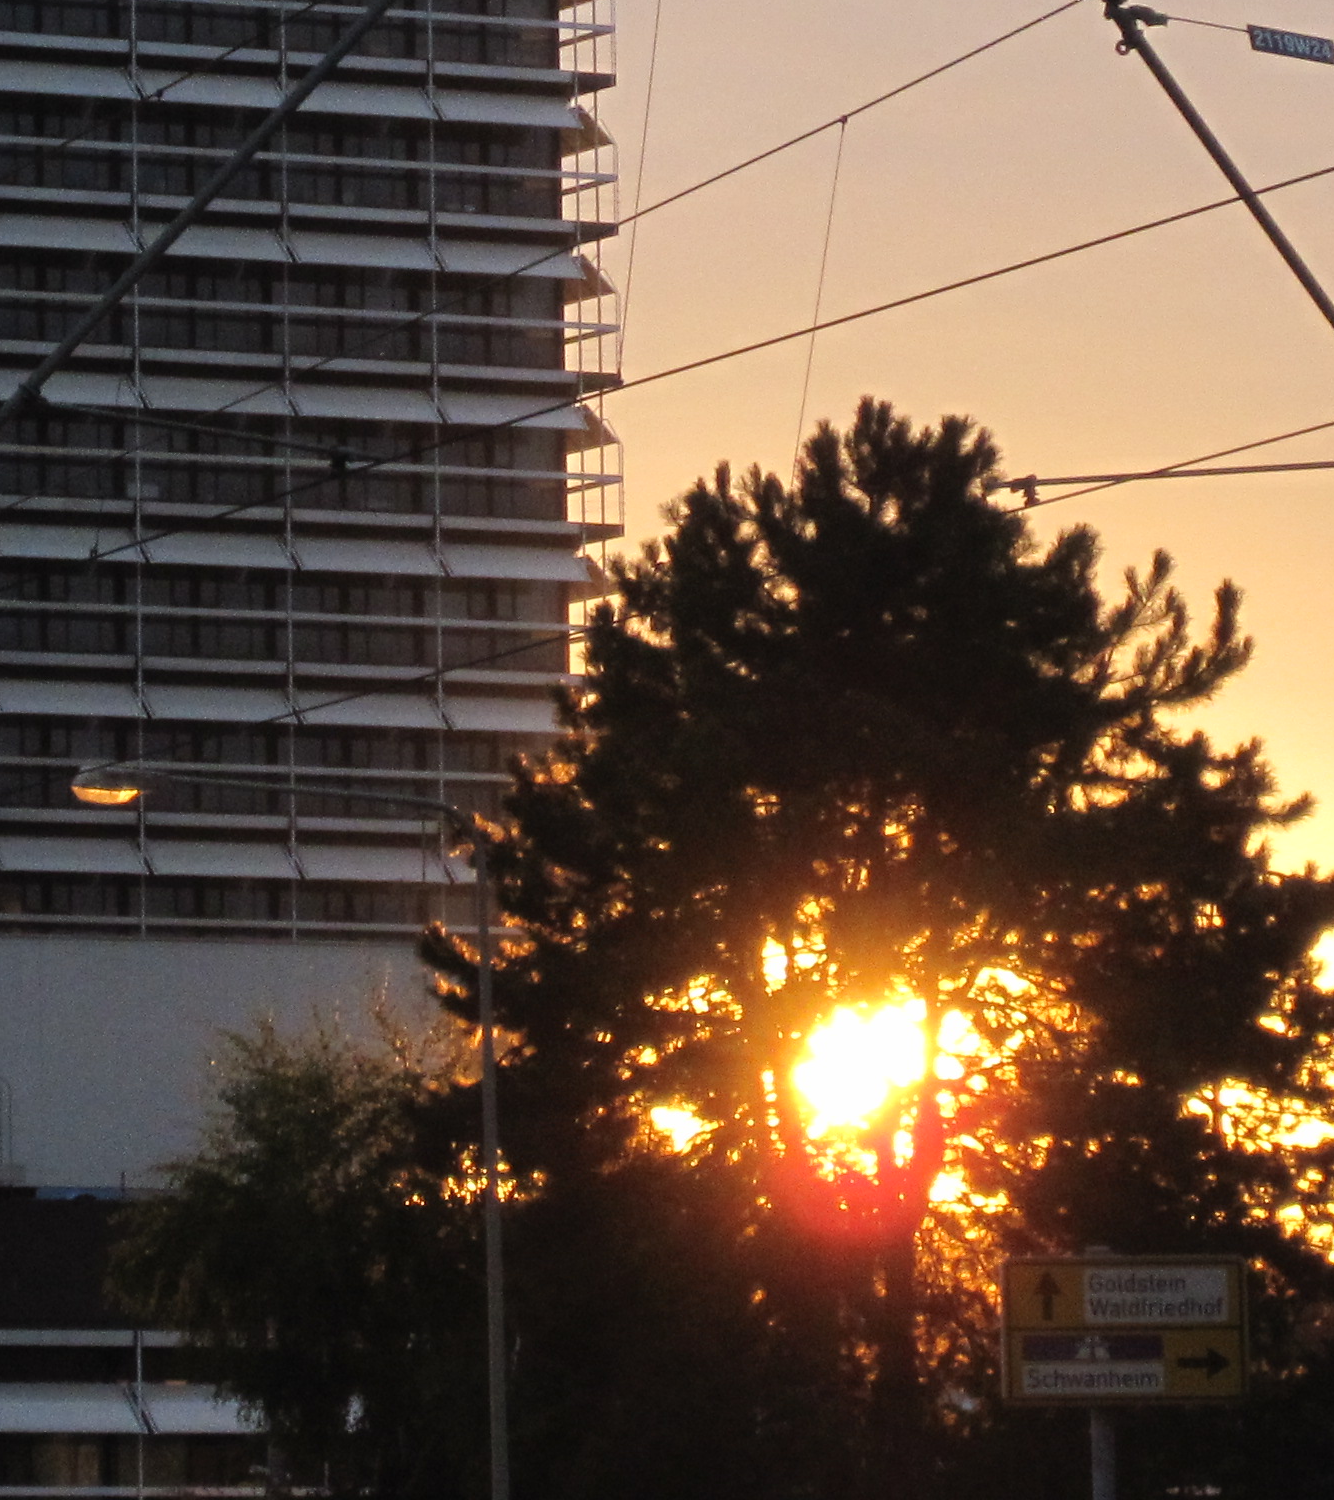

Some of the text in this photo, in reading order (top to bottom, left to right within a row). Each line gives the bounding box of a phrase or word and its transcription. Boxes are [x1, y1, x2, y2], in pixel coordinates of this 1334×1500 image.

[1088, 1273, 1186, 1294] Goldstein
[1089, 1296, 1224, 1318] Waldfriedhof
[1026, 1368, 1159, 1389] Schwanheim
